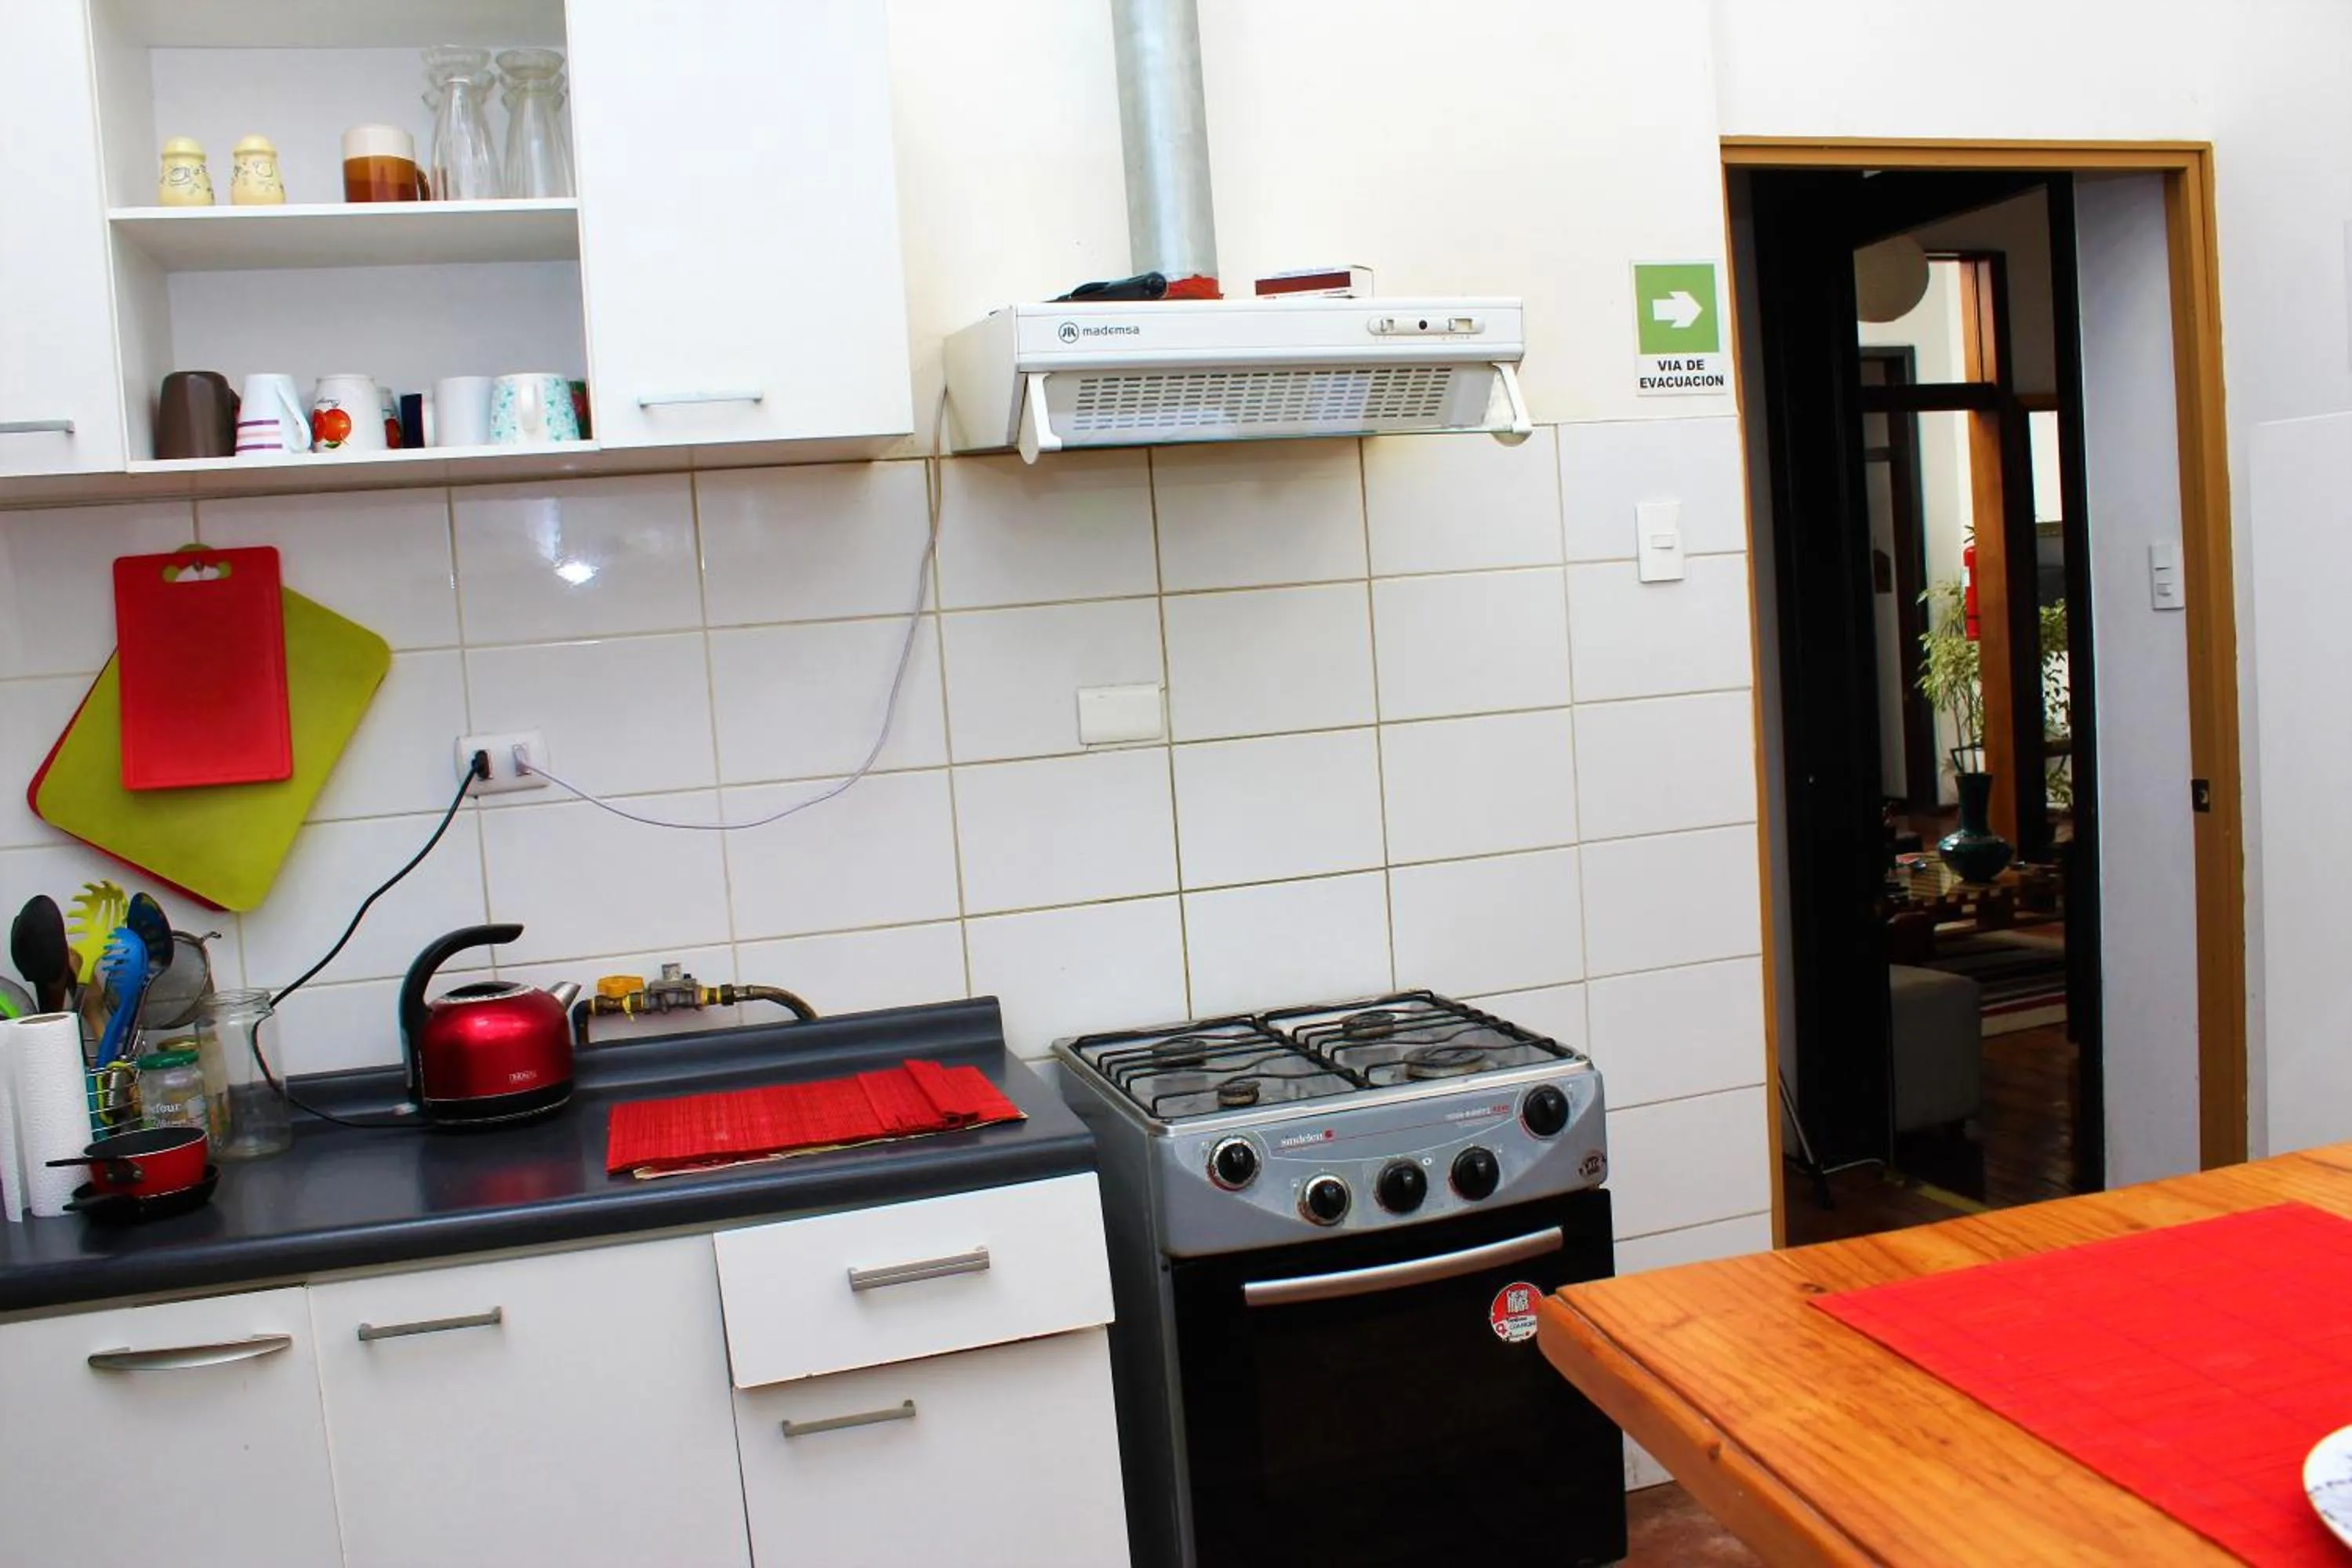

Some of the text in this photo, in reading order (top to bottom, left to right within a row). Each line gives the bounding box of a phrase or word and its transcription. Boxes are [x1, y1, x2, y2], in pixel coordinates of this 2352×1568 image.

[1082, 325, 1139, 336] mademsa
[1657, 359, 1705, 372] VIA DE
[1639, 375, 1724, 389] EVACUACION
